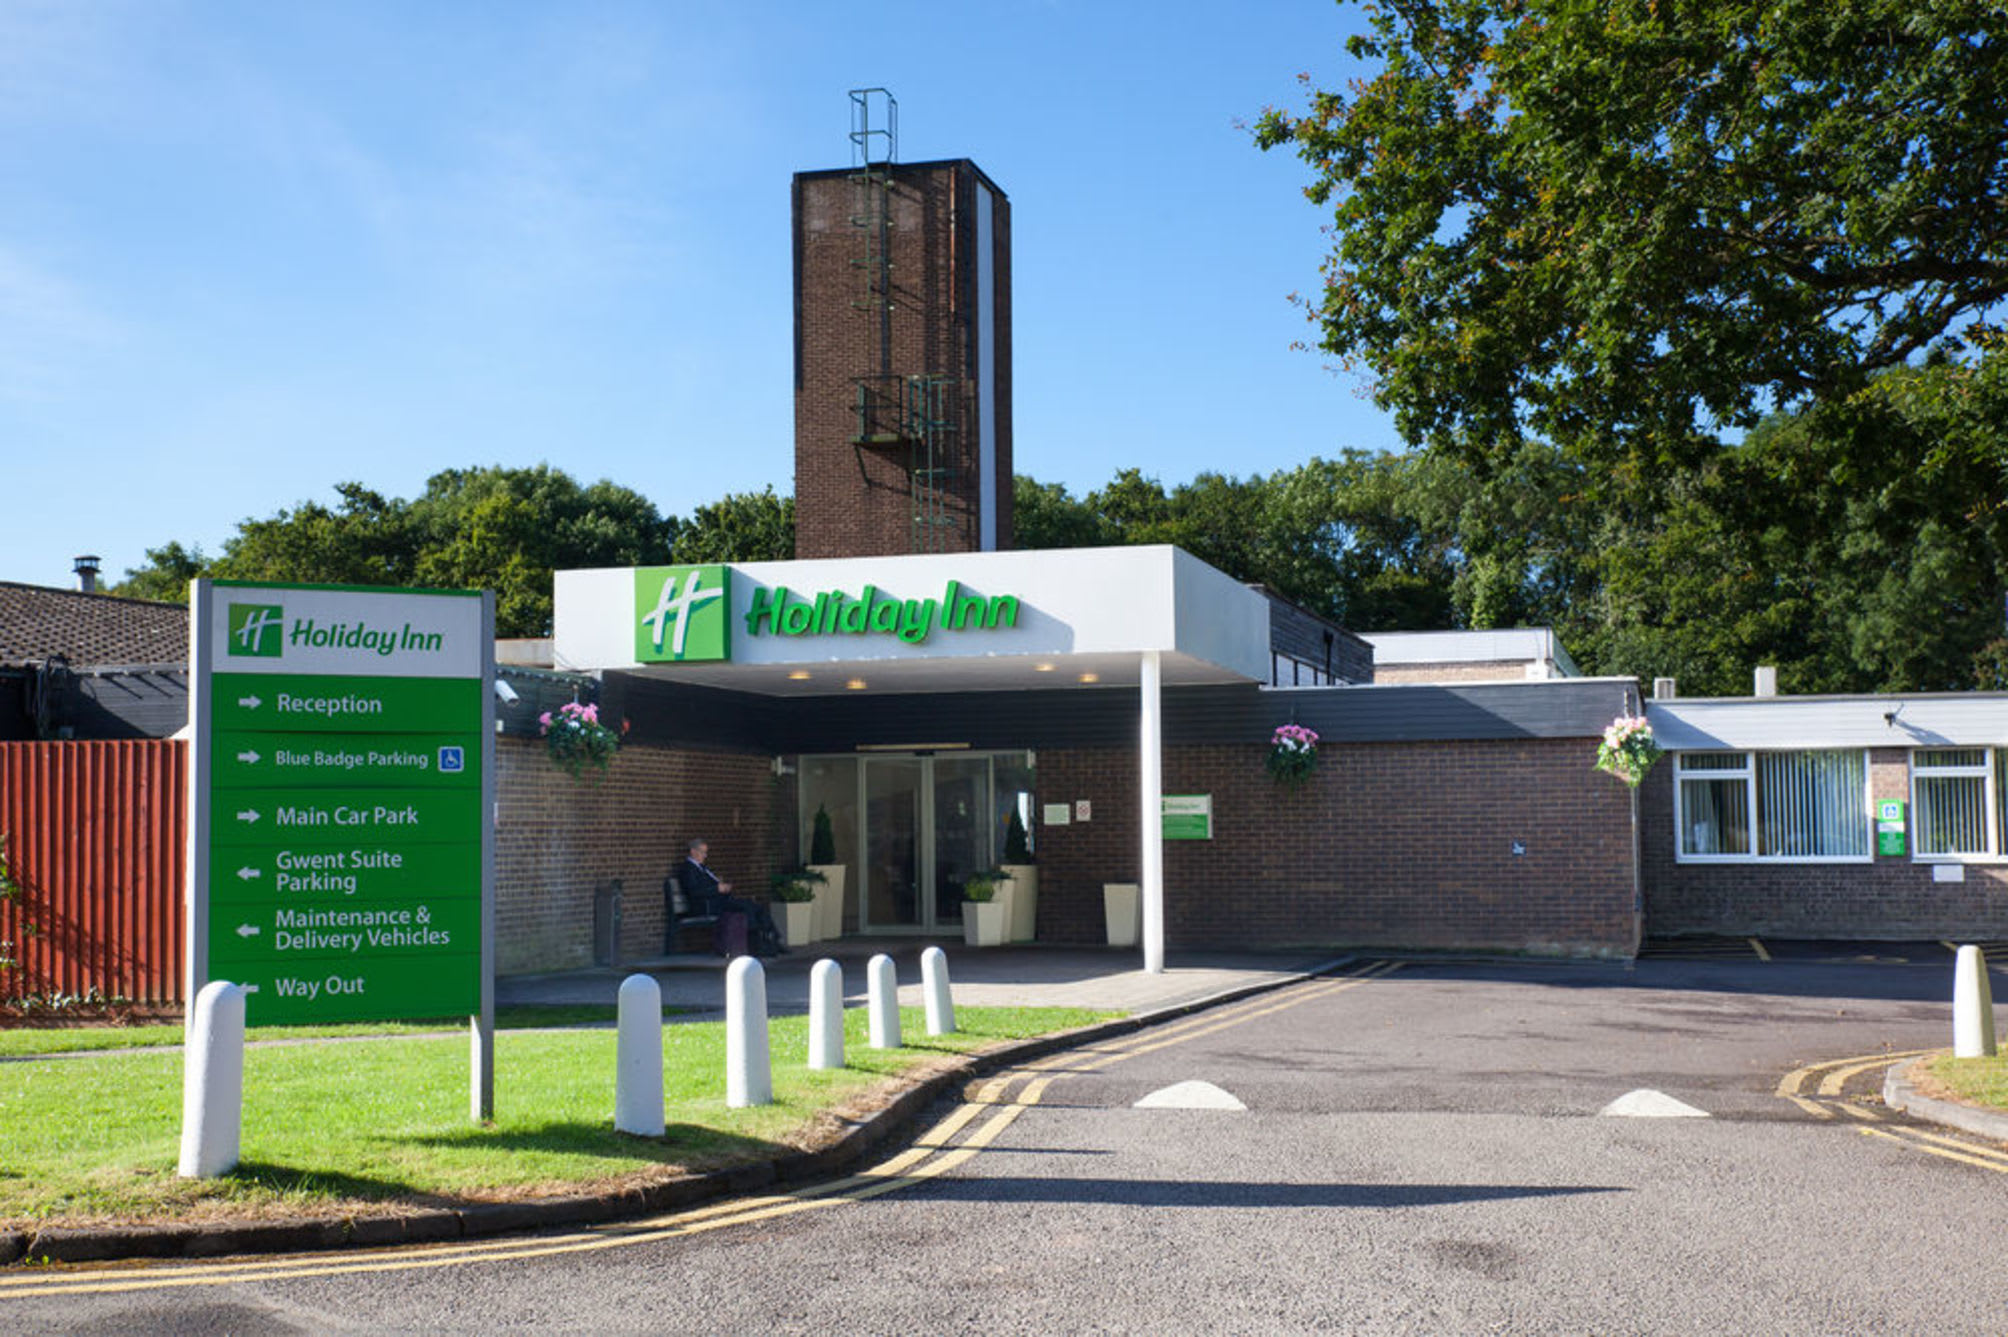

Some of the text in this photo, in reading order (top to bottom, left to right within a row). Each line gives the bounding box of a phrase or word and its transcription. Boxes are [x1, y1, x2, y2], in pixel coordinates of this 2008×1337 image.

[745, 585, 936, 644] Holiday
[940, 580, 1021, 631] Inn
[290, 618, 396, 657] Holiday
[400, 623, 443, 652] Inn
[277, 693, 382, 717] Reception
[276, 750, 428, 771] Blue Badge Parking
[276, 806, 418, 826] Main Car Park
[276, 850, 402, 870] Gwent Suite
[276, 872, 356, 894] Parking
[275, 906, 432, 928] Maintenance &
[275, 926, 450, 952] Delivery Vehicles
[275, 975, 364, 999] Way Out
